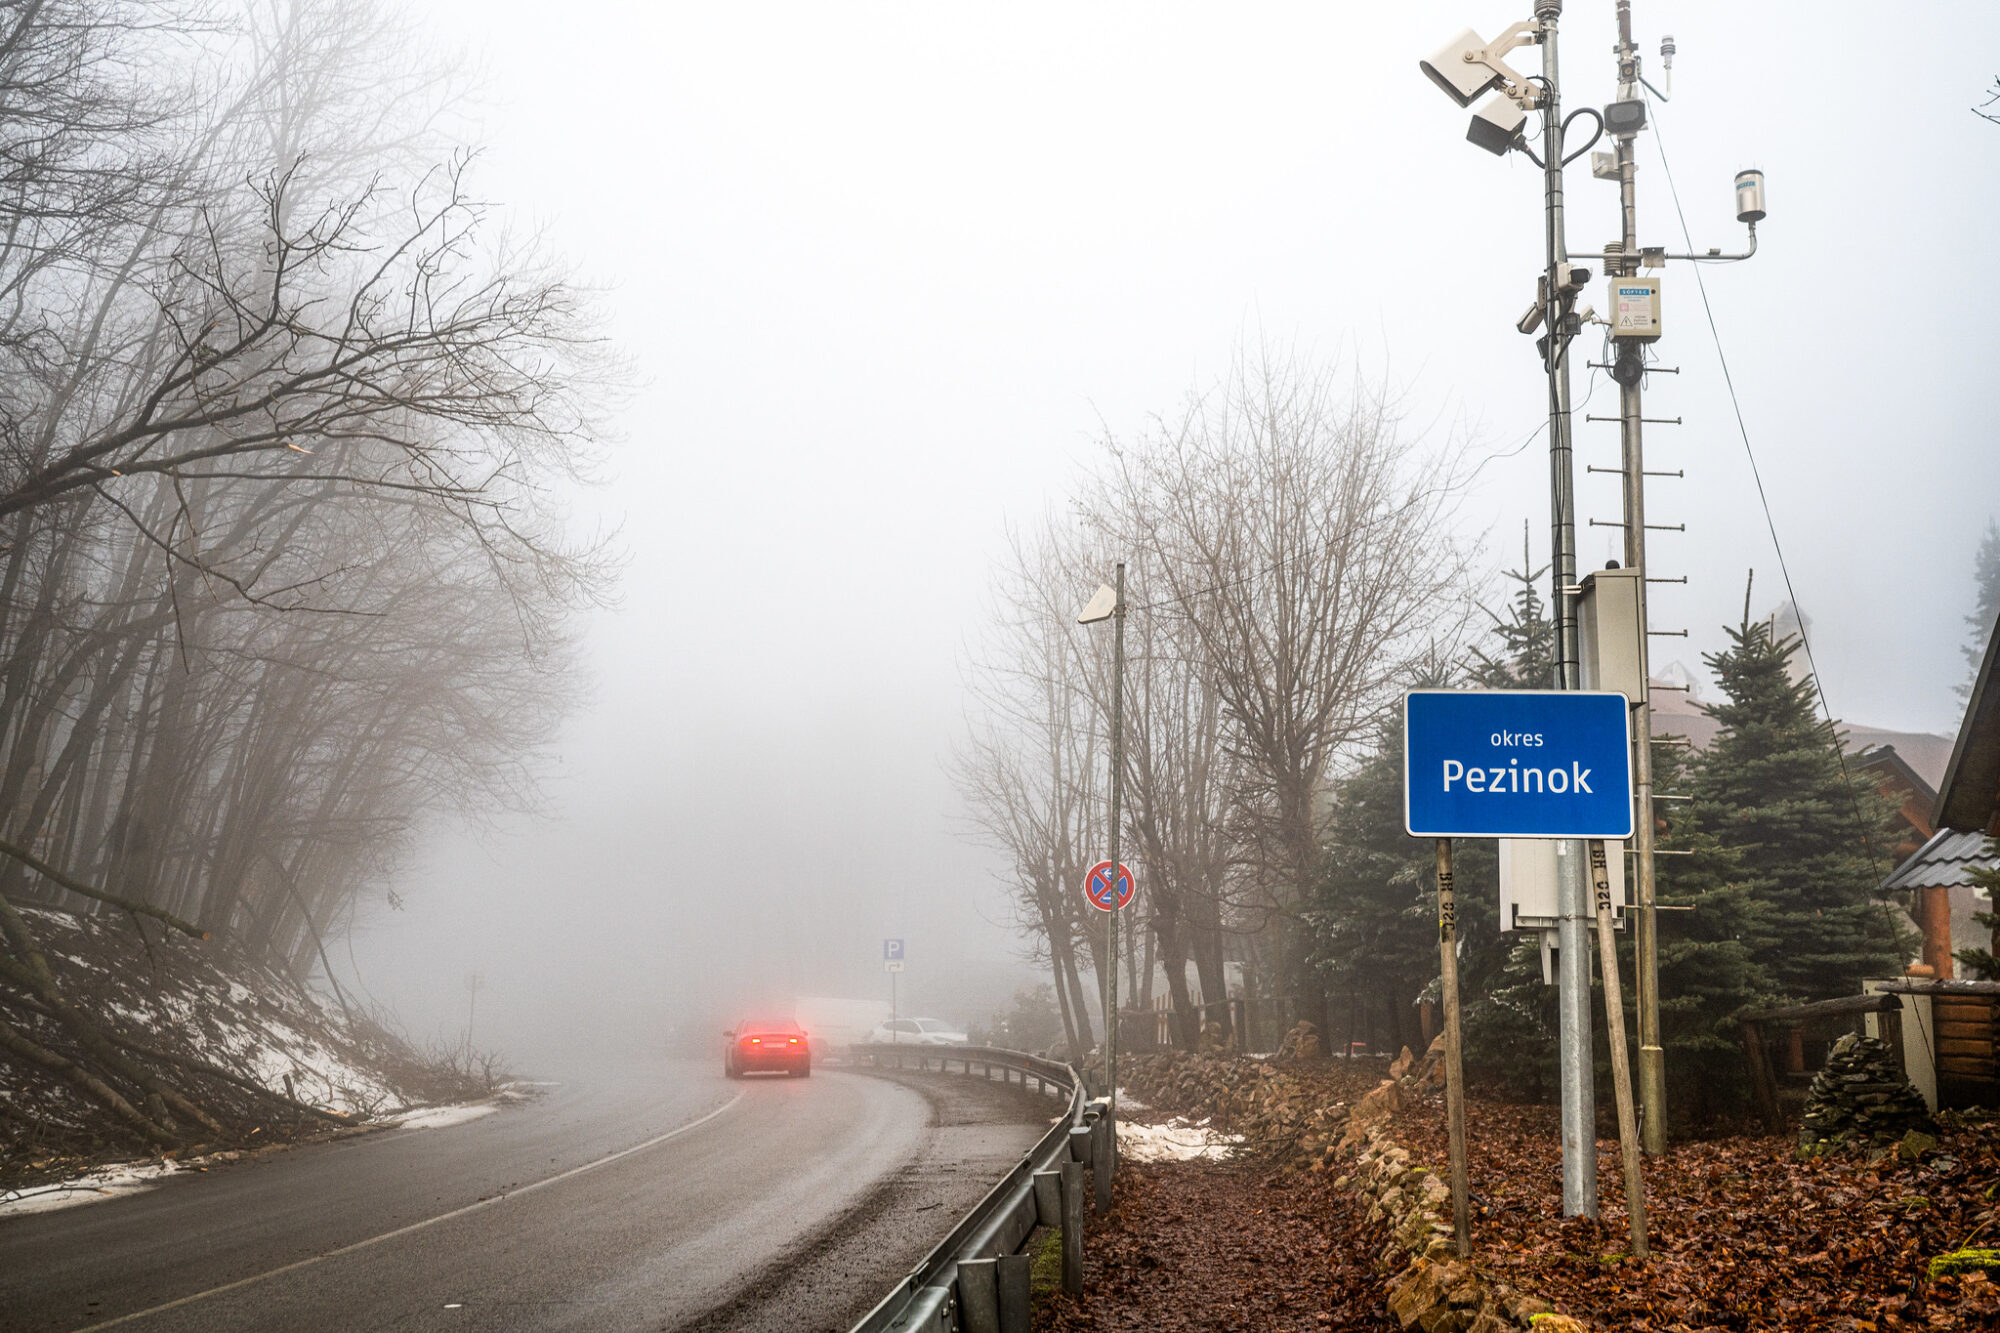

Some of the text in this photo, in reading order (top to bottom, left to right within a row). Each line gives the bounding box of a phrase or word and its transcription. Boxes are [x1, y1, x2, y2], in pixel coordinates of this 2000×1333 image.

[1490, 729, 1544, 747] okres
[1442, 758, 1593, 794] Pezinok
[888, 941, 900, 957] P
